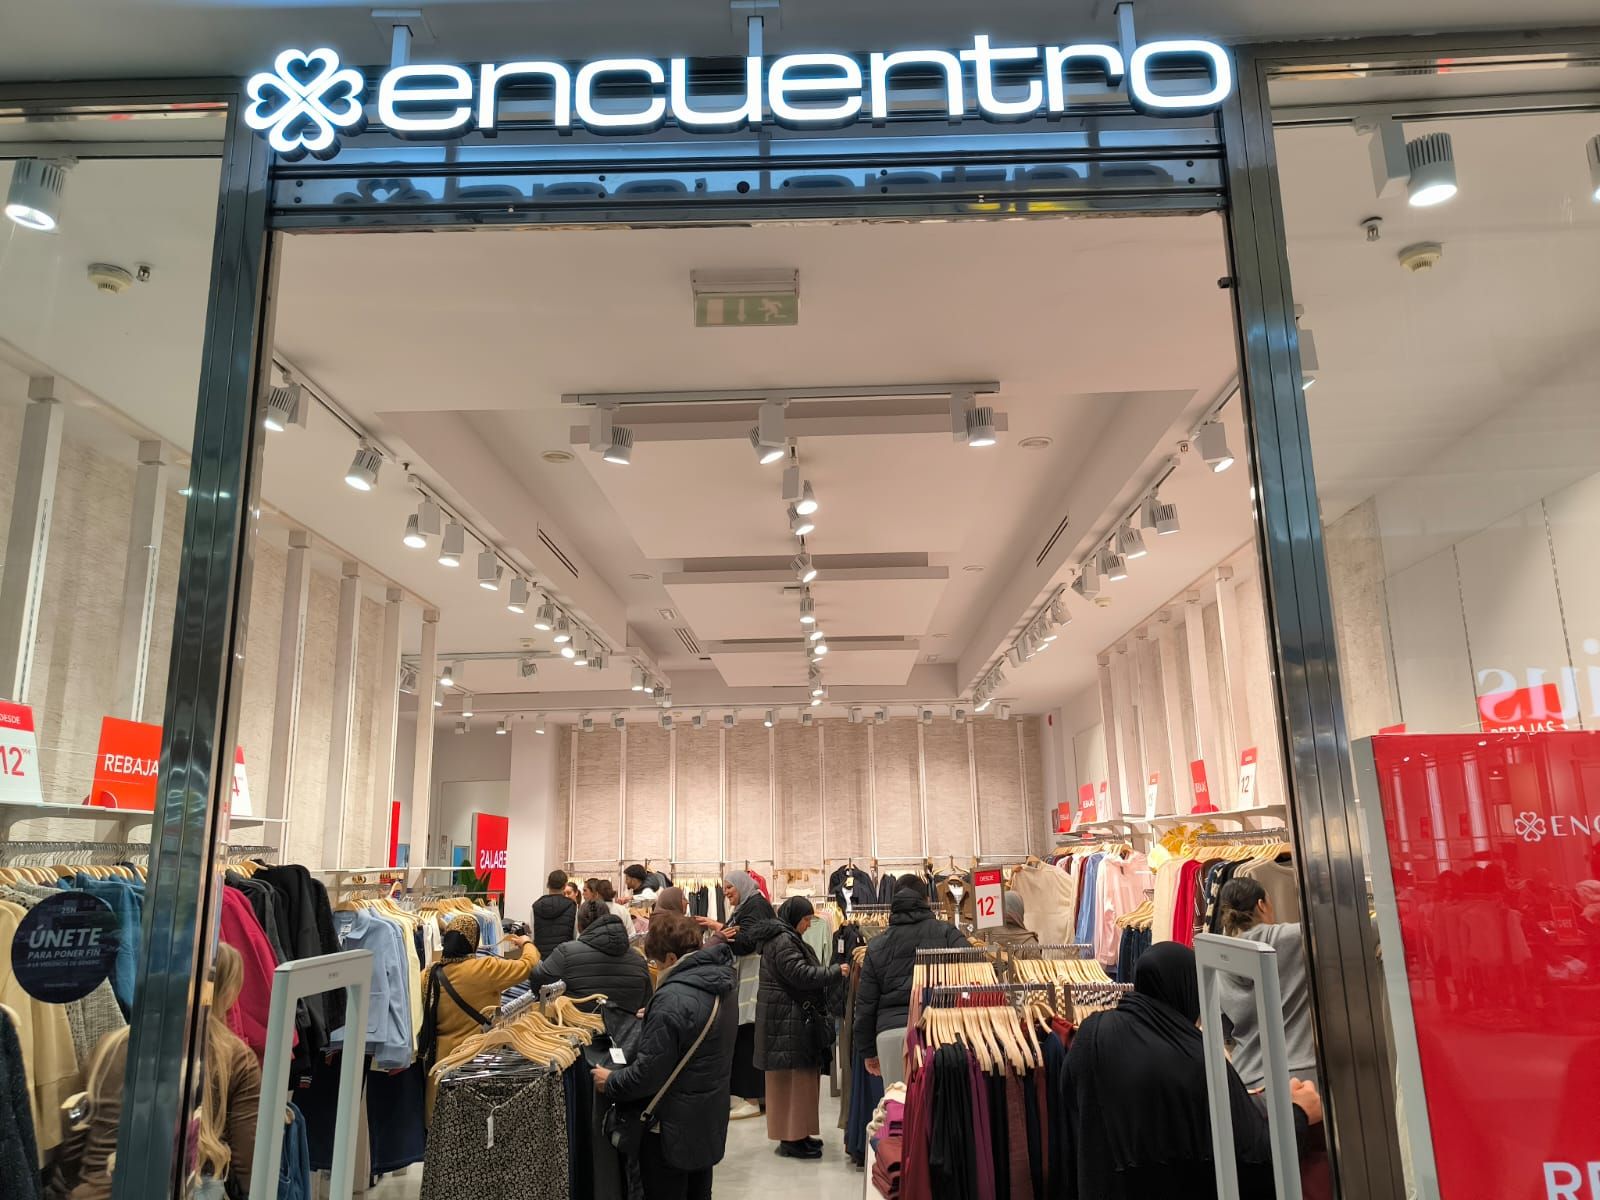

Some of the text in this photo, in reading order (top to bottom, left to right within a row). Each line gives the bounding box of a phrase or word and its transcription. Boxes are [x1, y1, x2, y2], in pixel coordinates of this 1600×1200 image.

[376, 34, 1235, 136] encuentro
[0, 745, 25, 776] 12
[977, 896, 995, 917] 12
[28, 924, 103, 949] ÚNETE
[27, 948, 101, 960] PARA PONER FIN
